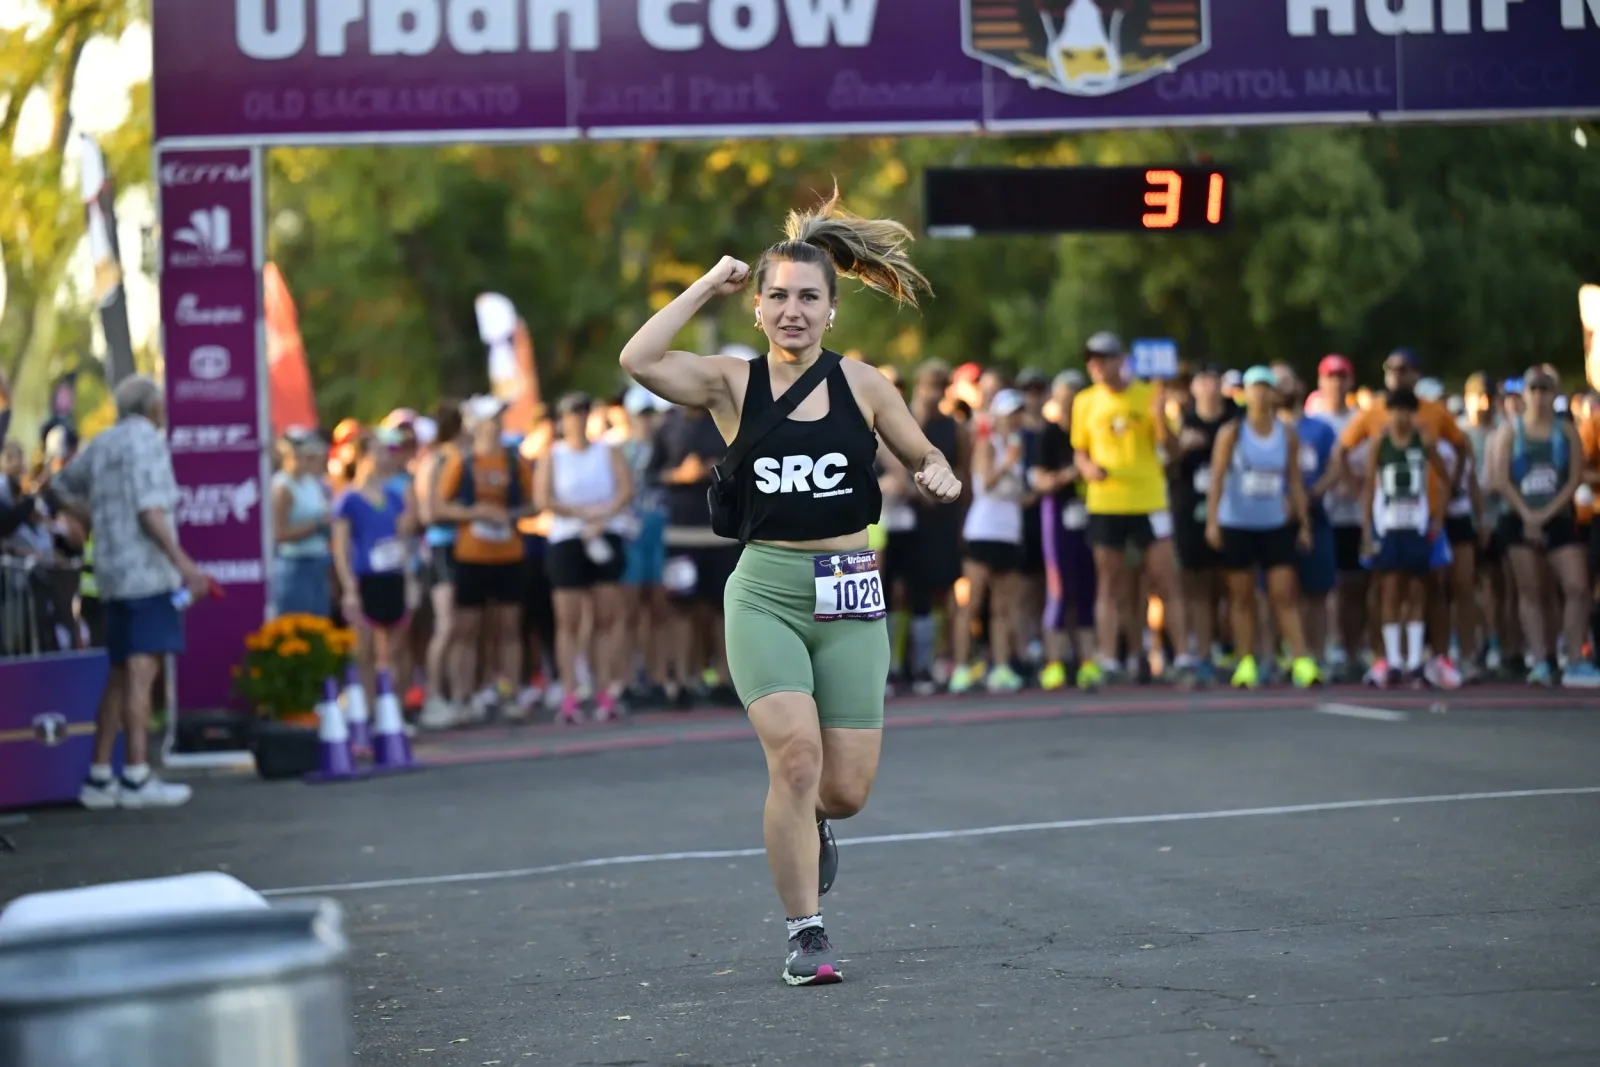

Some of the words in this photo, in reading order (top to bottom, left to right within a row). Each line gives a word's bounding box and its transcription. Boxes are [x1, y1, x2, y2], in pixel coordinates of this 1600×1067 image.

[235, 0, 600, 60] Urban
[1153, 67, 1296, 102] CAPITOL
[1304, 65, 1392, 97] MALL
[1142, 170, 1224, 228] 31
[753, 452, 849, 494] SRC
[847, 554, 872, 565] Urban
[833, 576, 882, 611] 1028
